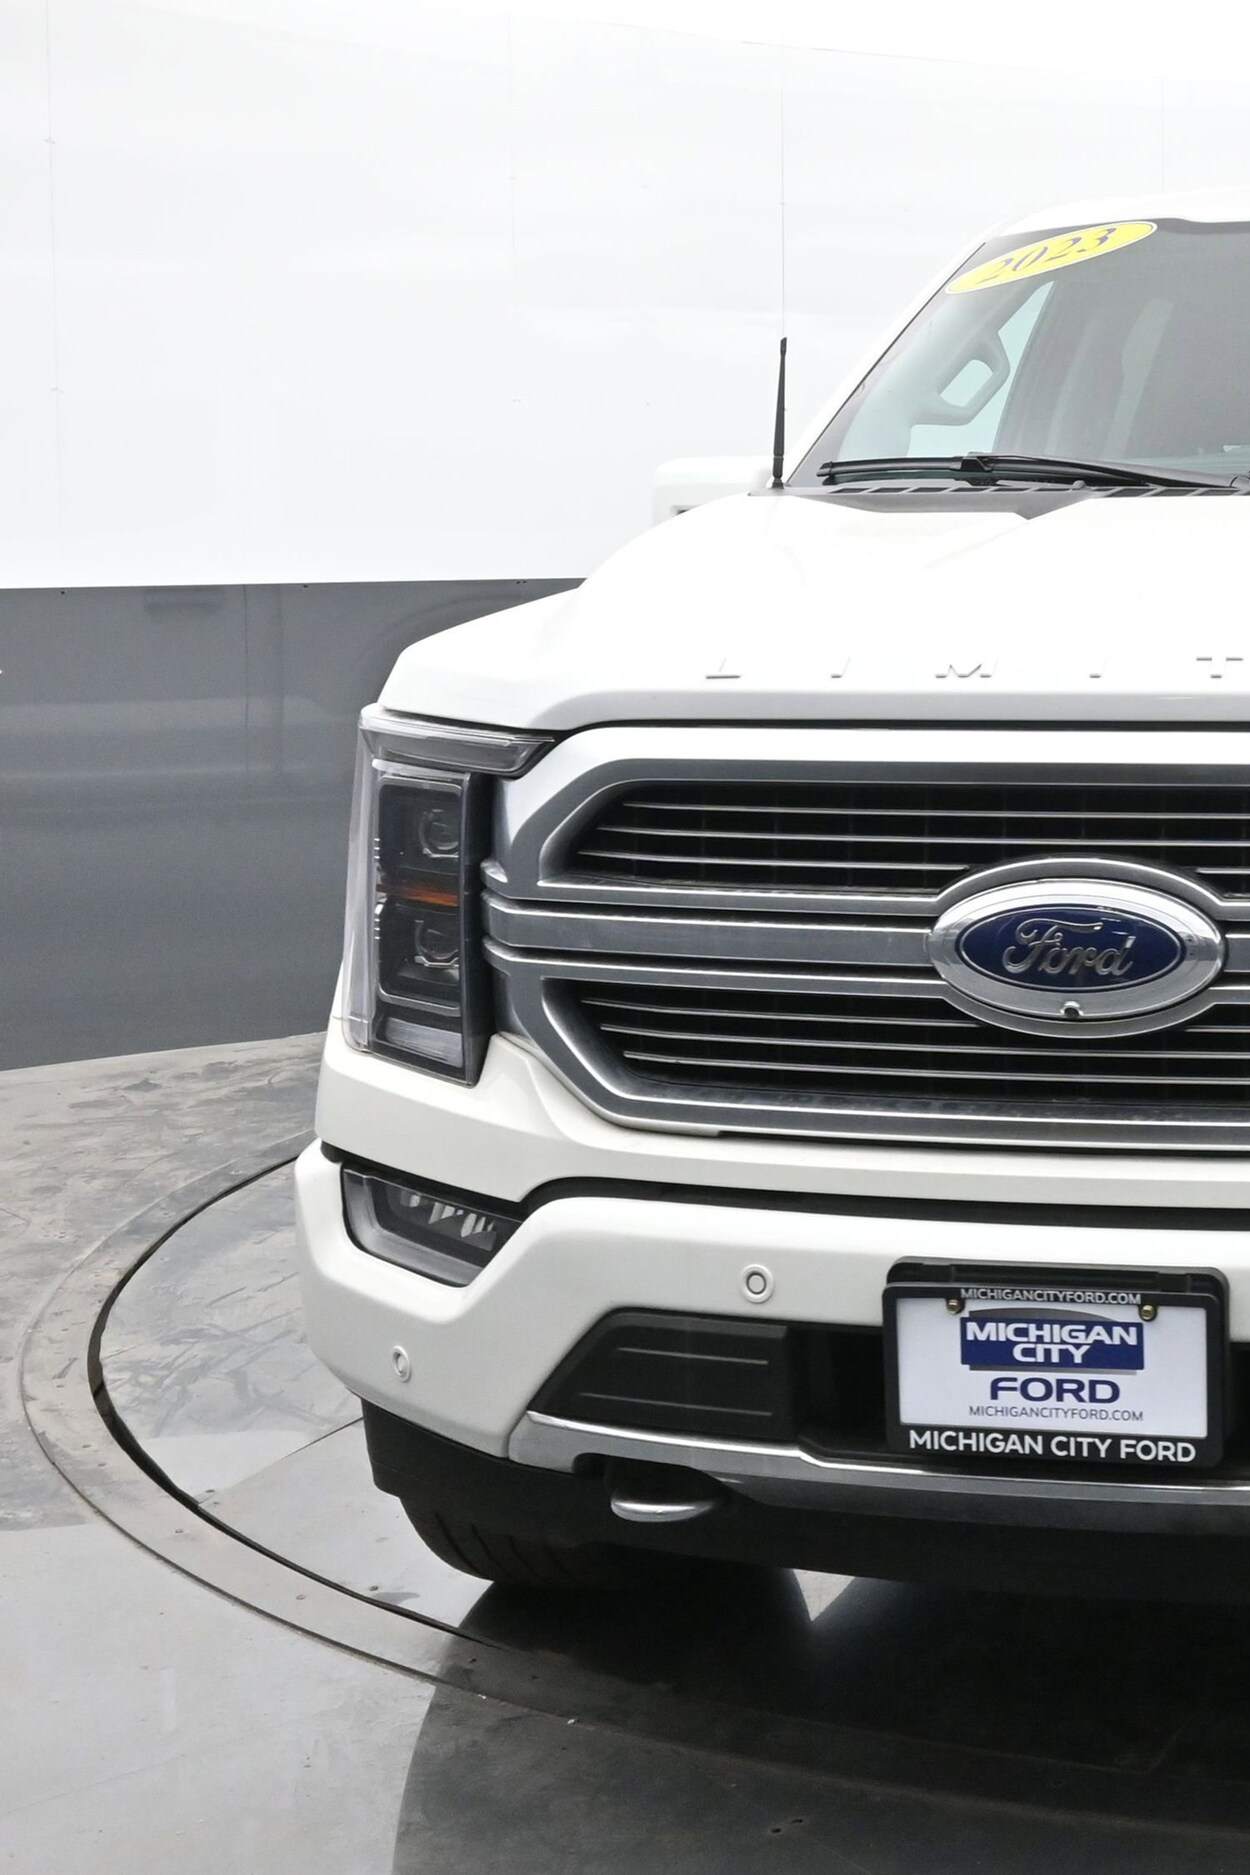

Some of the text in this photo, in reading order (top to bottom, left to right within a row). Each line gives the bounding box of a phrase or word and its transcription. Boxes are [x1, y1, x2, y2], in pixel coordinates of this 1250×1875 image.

[974, 227, 1117, 285] 2023
[1002, 917, 1136, 976] Ford
[960, 1288, 1142, 1305] MICHIGANCITYFORD.COM
[966, 1321, 1138, 1345] MICHIGAN
[1013, 1343, 1091, 1364] CITY
[989, 1376, 1121, 1404] FORD
[968, 1405, 1144, 1422] MICHIGANCITYFORD.COM
[909, 1429, 1197, 1463] MICHIGAN CITY FORD
